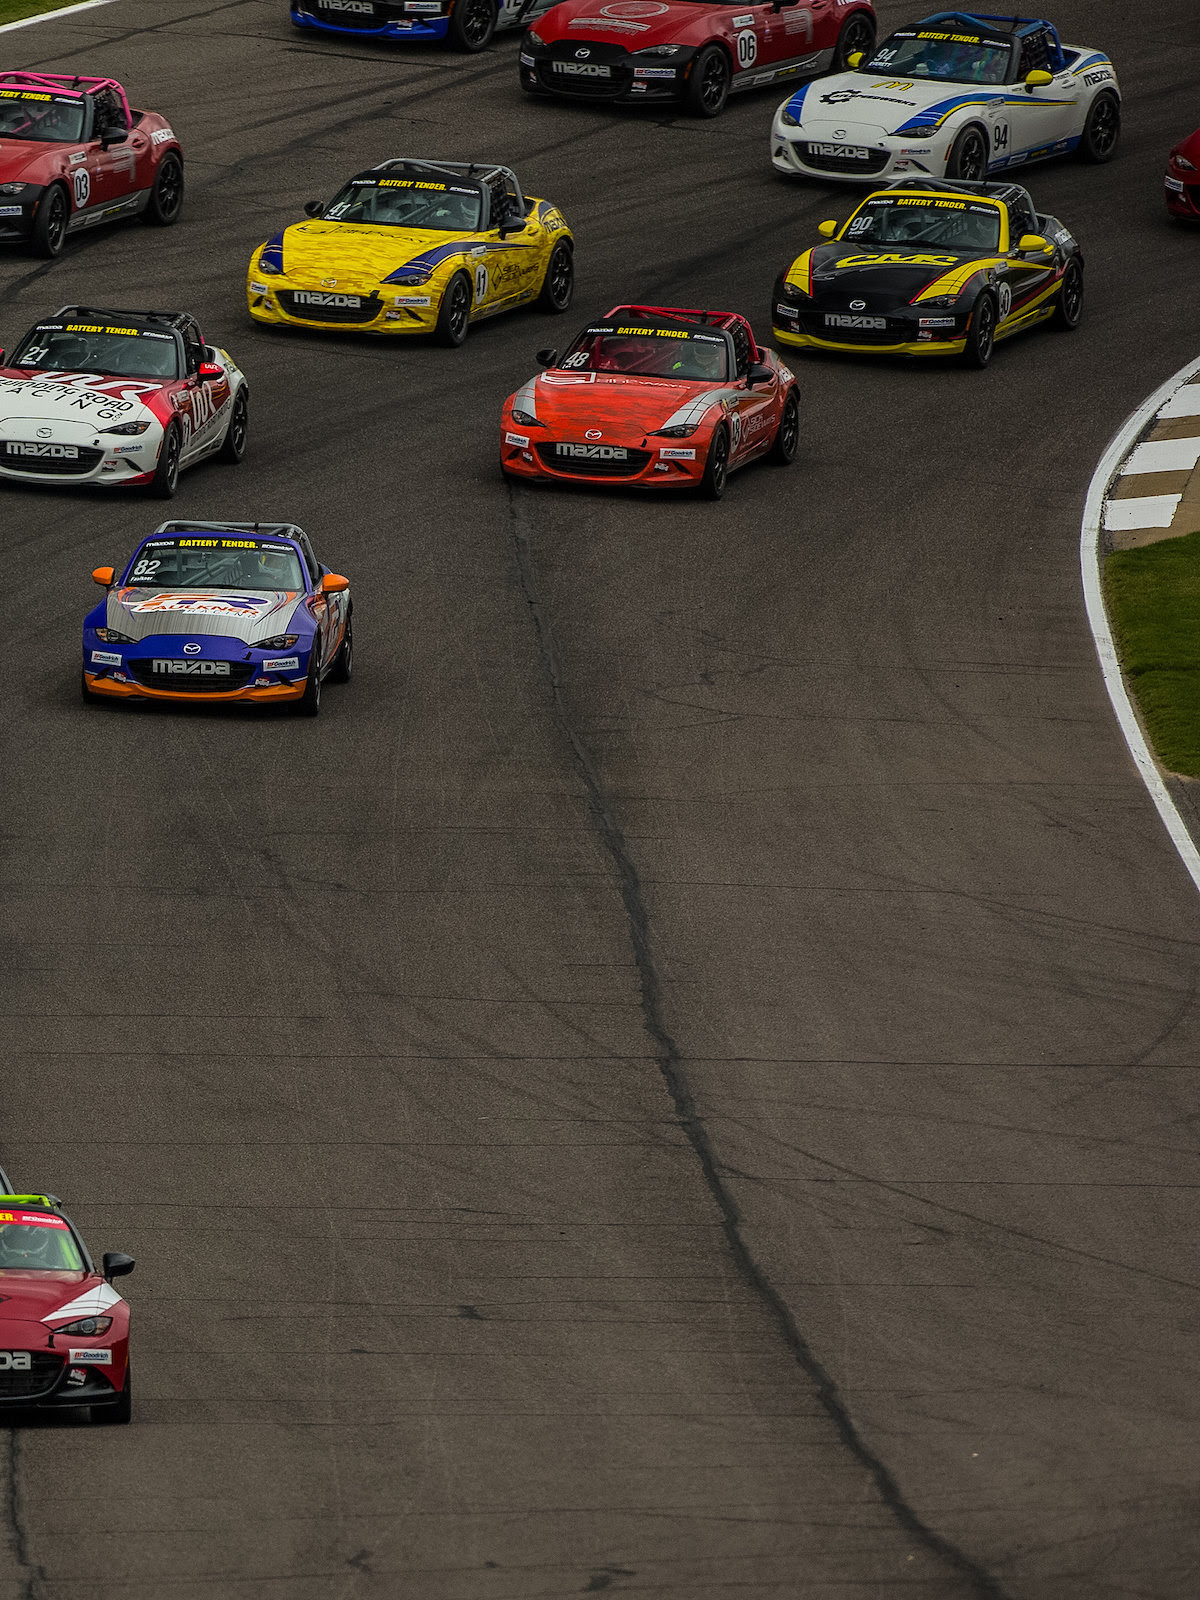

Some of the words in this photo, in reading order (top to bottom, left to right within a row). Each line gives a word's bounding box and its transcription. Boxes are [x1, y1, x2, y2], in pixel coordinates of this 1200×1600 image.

[917, 31, 949, 40] BATTERY
[739, 34, 755, 63] 06
[877, 49, 897, 62] 94
[552, 61, 611, 77] mazda
[994, 124, 1007, 150] 94
[808, 142, 869, 159] mazda
[75, 175, 88, 200] 03
[378, 180, 413, 188] BATTERY
[328, 202, 351, 216] 41
[897, 199, 932, 207] BATTERY
[851, 217, 873, 231] 90
[836, 254, 959, 268] CMC
[294, 291, 361, 308] mazda
[66, 325, 103, 333] BATTERY
[825, 314, 886, 329] mazda
[617, 327, 654, 336] BATTERY
[25, 347, 48, 361] 21
[566, 352, 589, 367] 48
[82, 390, 134, 412] ROAD
[7, 441, 78, 458] mazda
[556, 443, 627, 459] mazda
[134, 560, 161, 575] 82
[139, 604, 260, 616] FAULKNER
[153, 659, 230, 675] mazda
